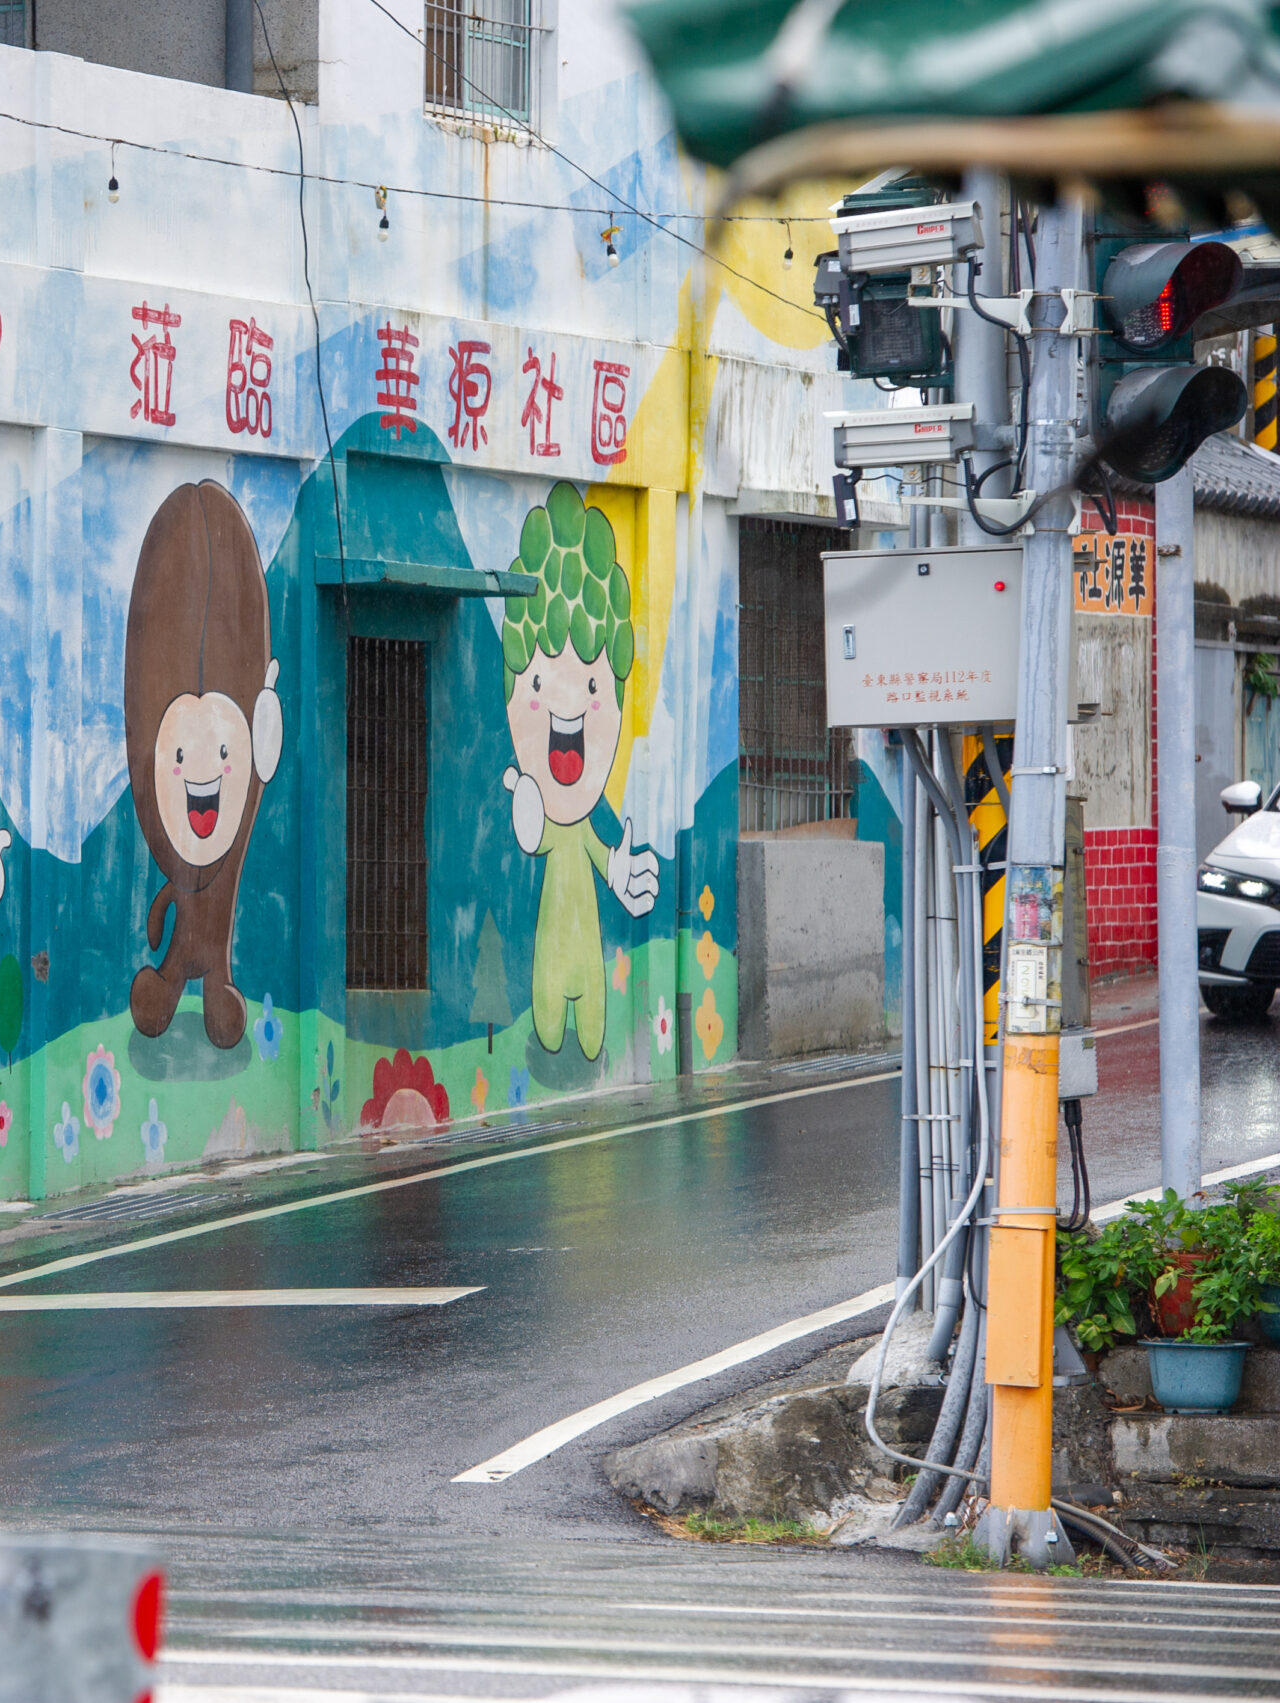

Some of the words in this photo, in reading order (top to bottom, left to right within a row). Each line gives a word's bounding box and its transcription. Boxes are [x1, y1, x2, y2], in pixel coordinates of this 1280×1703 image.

[885, 687, 970, 704] 路口監視系統
